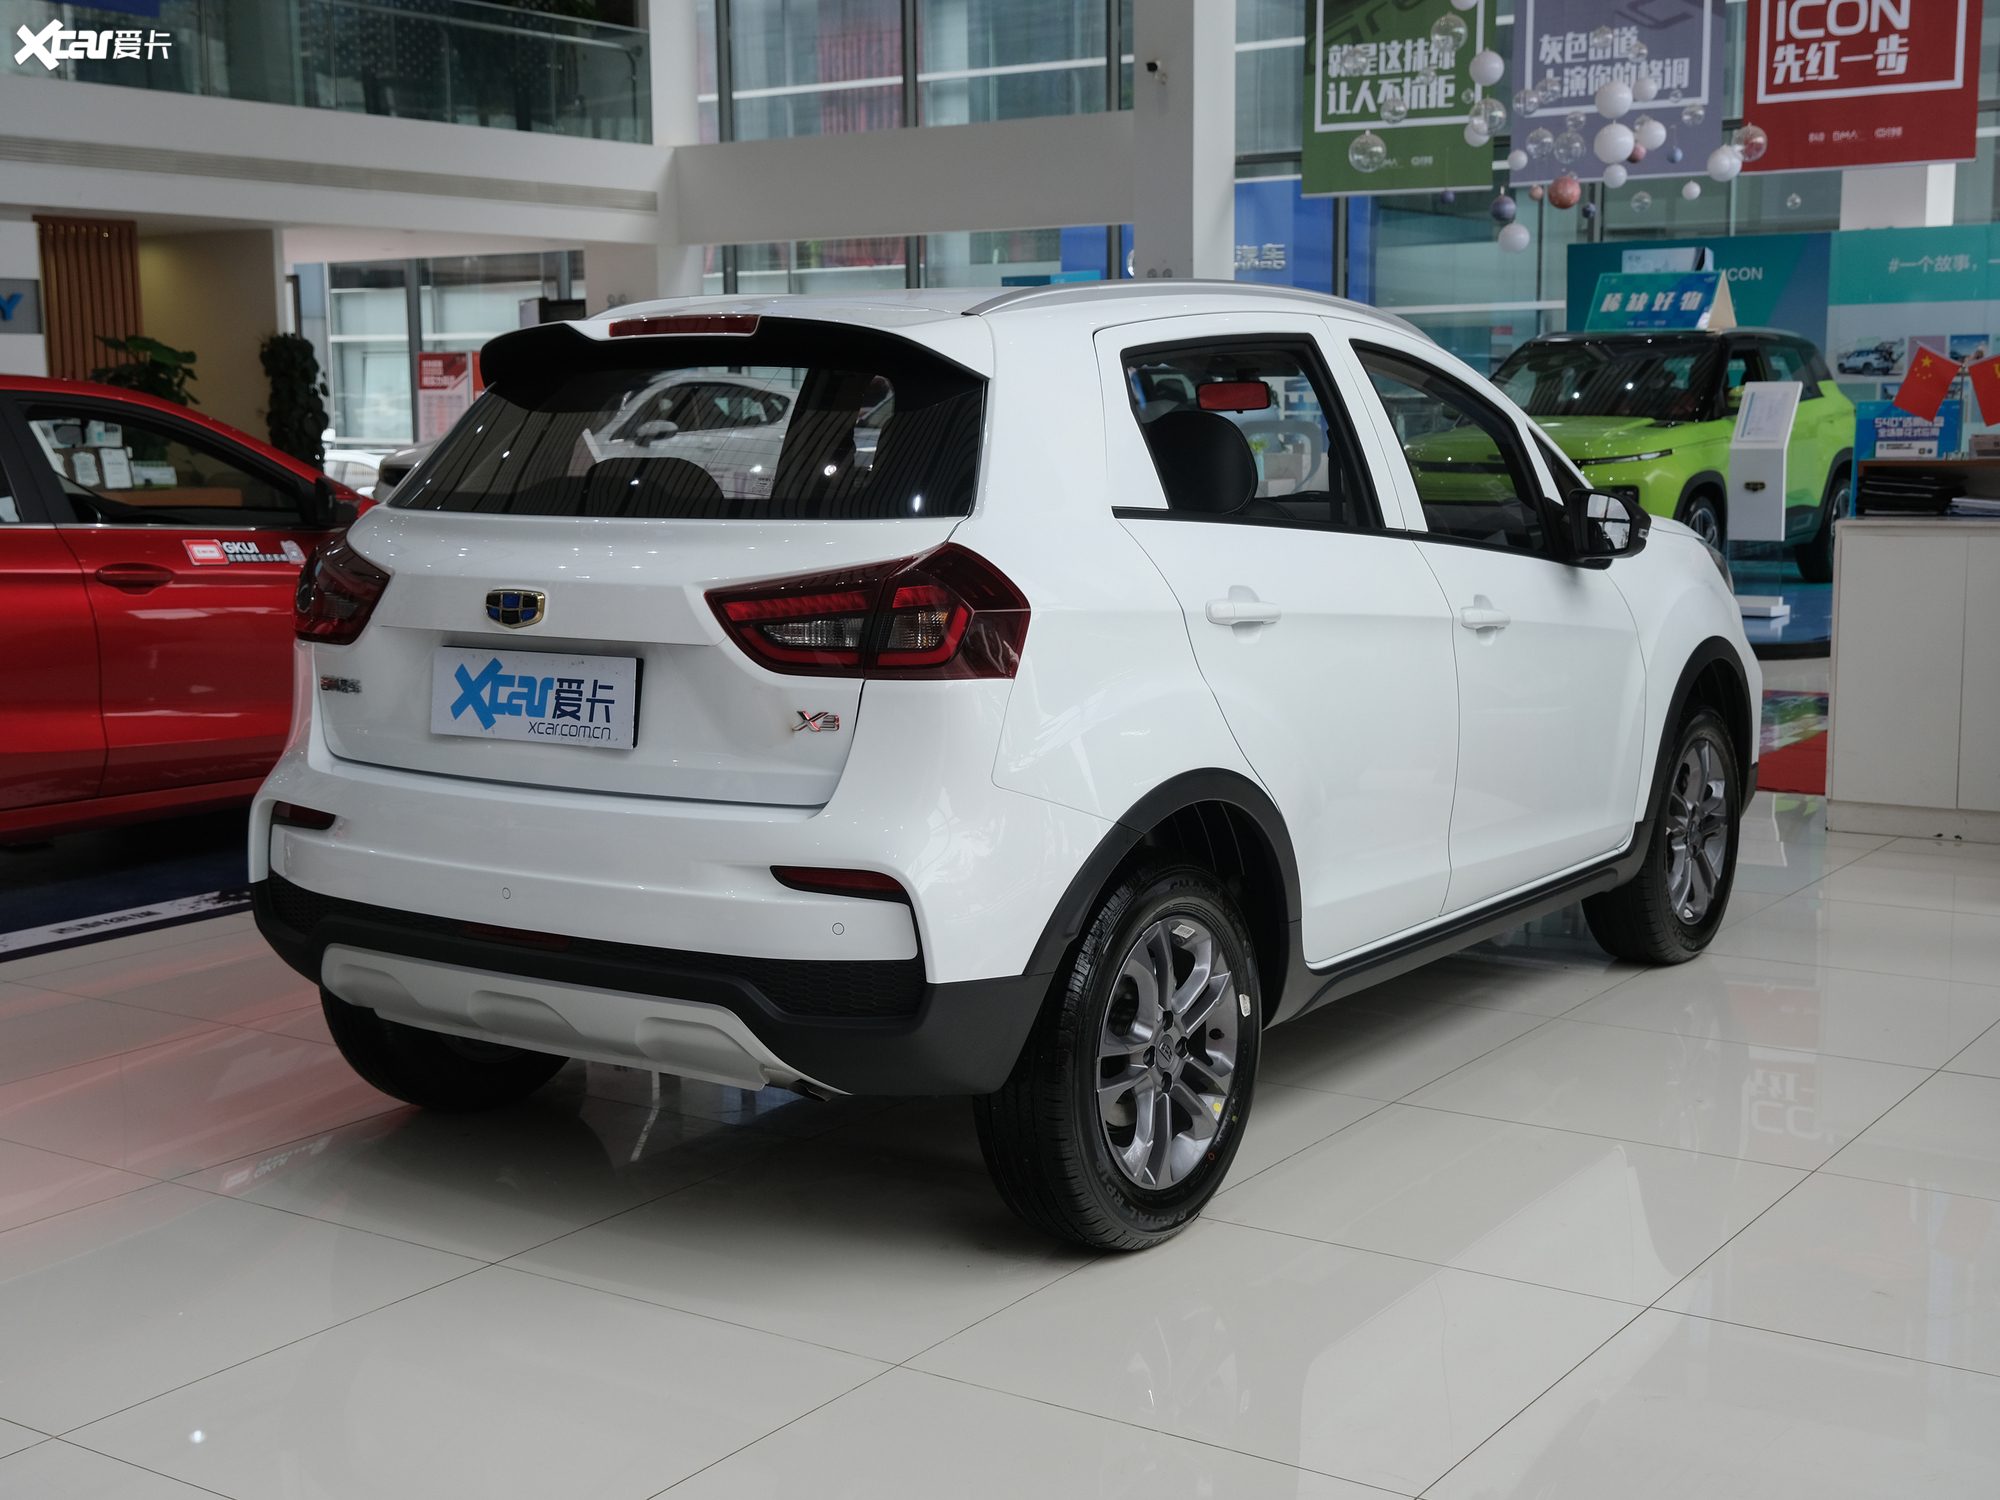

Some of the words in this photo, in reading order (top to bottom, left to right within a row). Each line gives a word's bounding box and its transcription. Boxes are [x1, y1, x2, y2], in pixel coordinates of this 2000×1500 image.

[1776, 0, 1910, 41] ICON
[1539, 26, 1640, 65] 灰色出道
[1773, 34, 1909, 84] 先红一步
[1327, 75, 1456, 115] 让人不抗拒
[222, 541, 260, 554] GKUI
[552, 677, 616, 723] 爱卡
[527, 720, 612, 740] xcar.com.cn
[791, 710, 840, 732] X3
